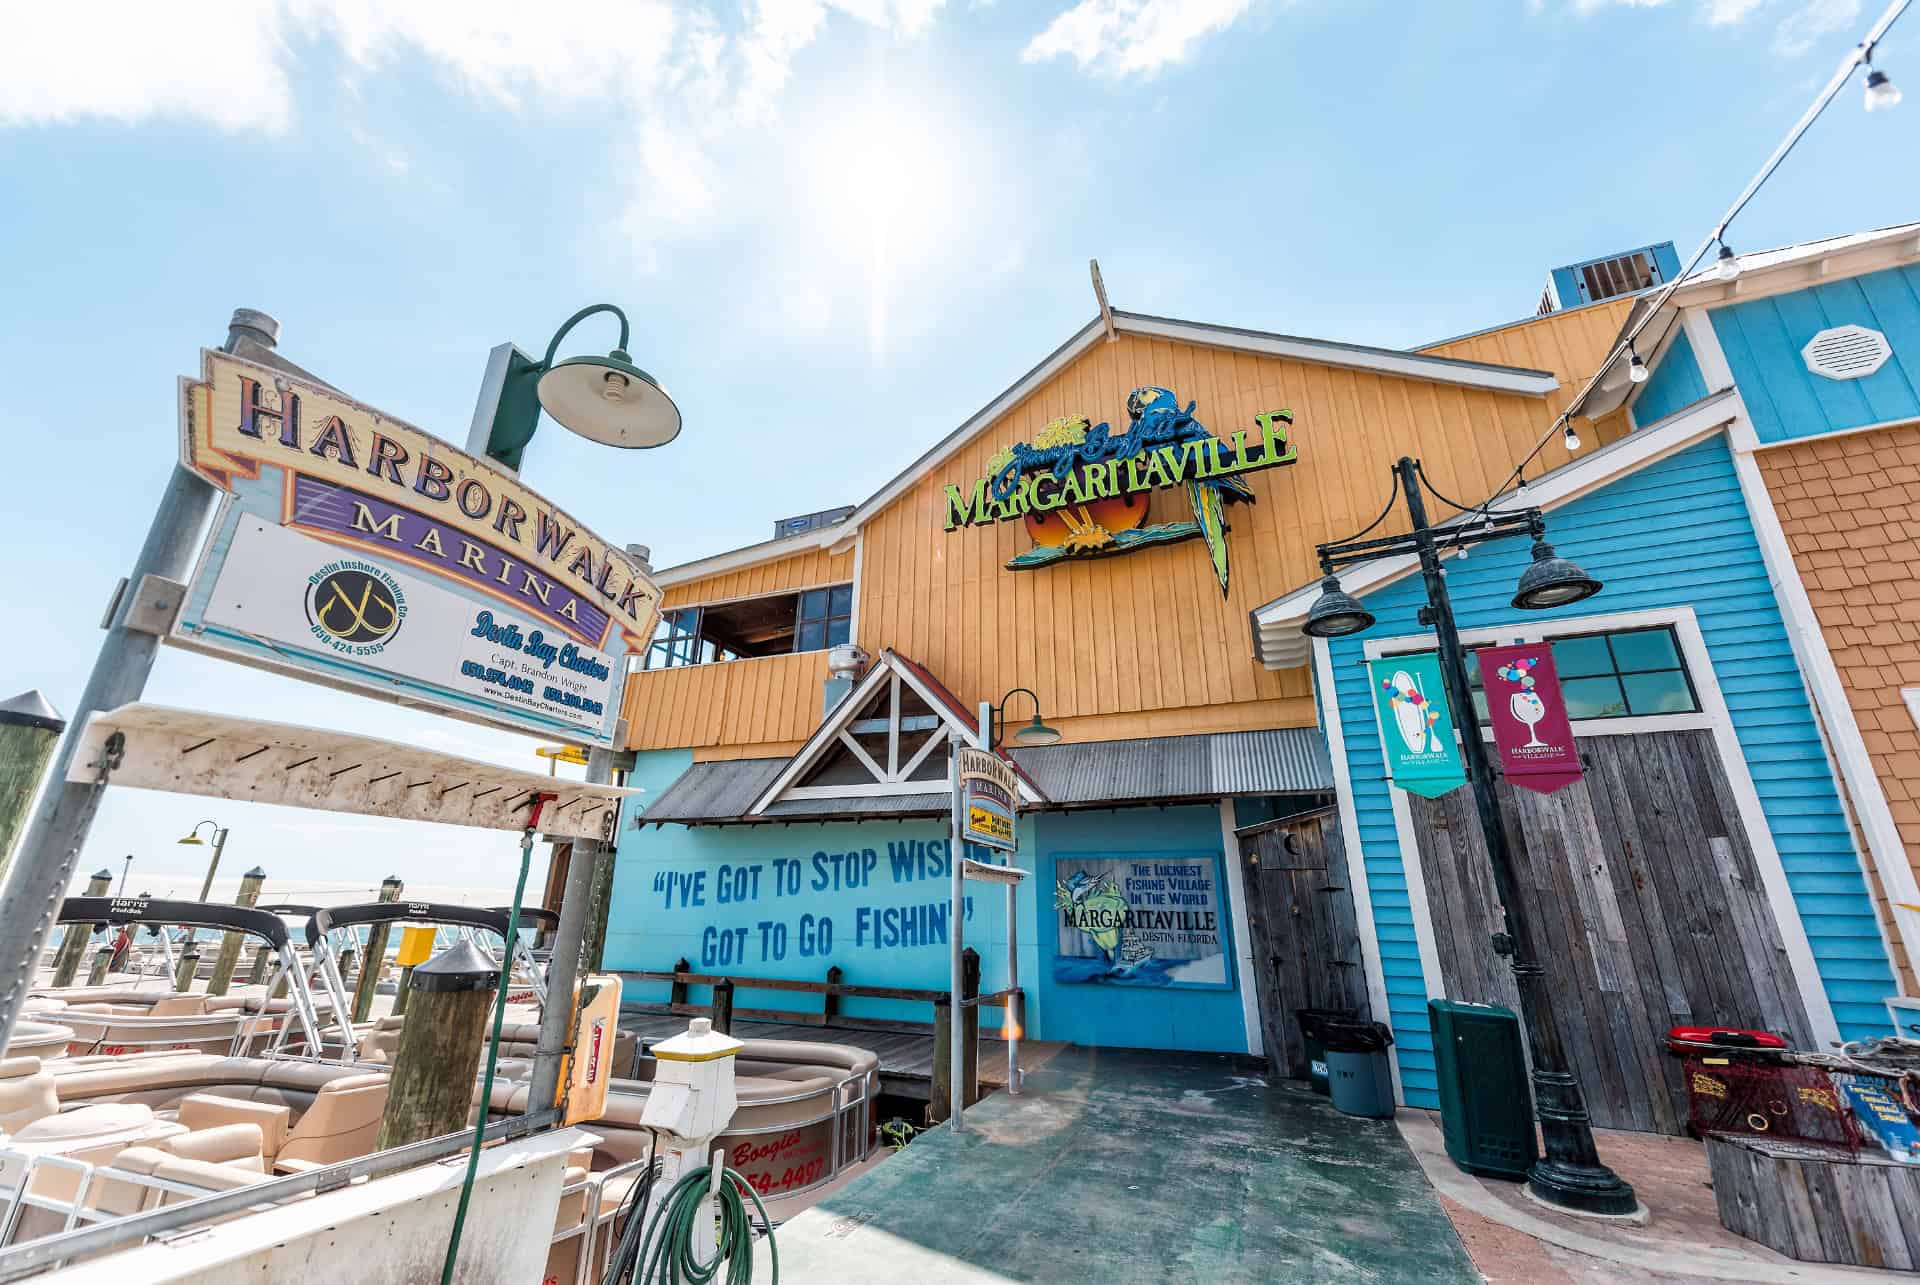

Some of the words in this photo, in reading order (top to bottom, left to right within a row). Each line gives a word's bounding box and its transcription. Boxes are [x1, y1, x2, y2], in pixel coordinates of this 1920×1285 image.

[944, 409, 1297, 532] MARGARITAVILLE
[238, 374, 649, 622] HARBORWALK
[308, 562, 341, 585] Destin
[340, 560, 381, 577] Inshore
[380, 572, 405, 605] Fishing
[351, 502, 580, 624] MARINA
[310, 624, 384, 656] 850-424-5555
[471, 610, 523, 651] Destin
[523, 630, 559, 669] Bay
[558, 643, 610, 682] Charters
[491, 653, 518, 671] Capt.
[521, 663, 558, 684] Brandon
[561, 678, 588, 694] Wright
[716, 864, 762, 904] GOT
[772, 858, 801, 896] TO
[811, 848, 877, 891] STOP
[1125, 878, 1165, 891] FISHING
[1168, 878, 1212, 891] VILLAGE
[1131, 864, 1151, 876] THE
[1155, 865, 1202, 876] LUCKIEST
[1064, 909, 1217, 931] MARGARITAVILLE
[1130, 894, 1142, 905] IN
[1145, 894, 1166, 905] THE
[1168, 893, 1208, 906] WORLD
[701, 926, 748, 967] GOT
[758, 921, 787, 961] TO
[800, 913, 832, 957] GO
[1178, 934, 1218, 945] FLORIDA
[732, 1130, 801, 1168] Boogies
